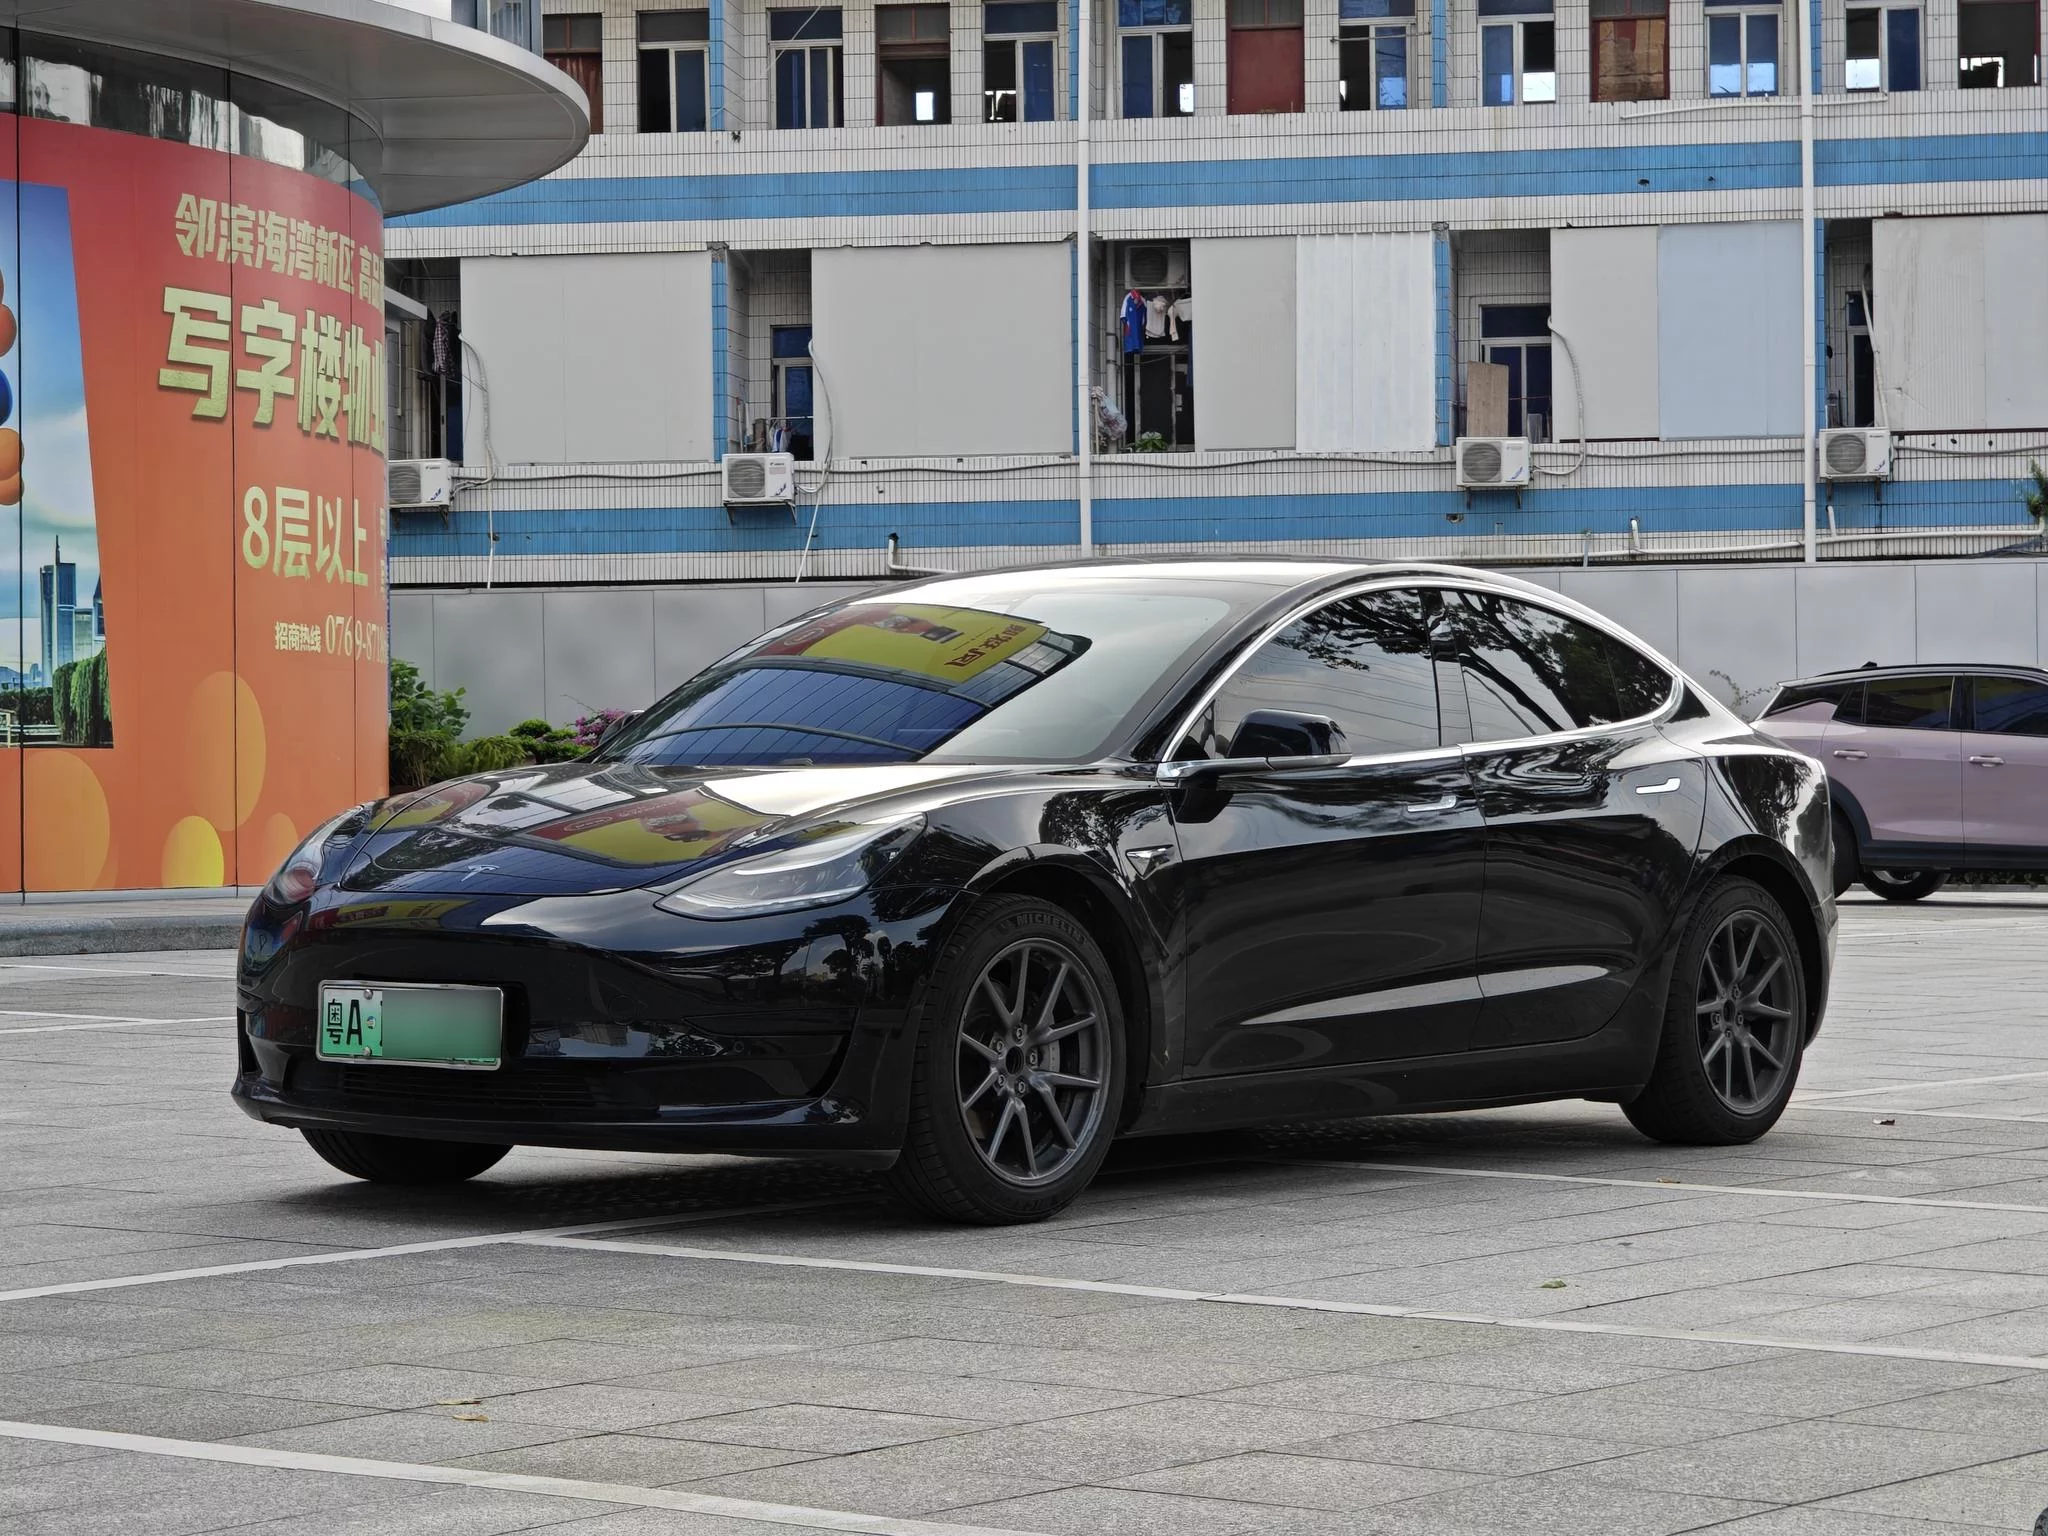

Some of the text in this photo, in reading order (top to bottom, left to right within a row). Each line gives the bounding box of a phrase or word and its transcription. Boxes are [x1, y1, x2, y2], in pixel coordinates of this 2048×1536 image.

[175, 193, 356, 295] 邻滨海湾新区
[242, 486, 368, 587] 8层以上
[275, 620, 321, 653] 招商热线
[1016, 912, 1087, 945] MICHELIN
